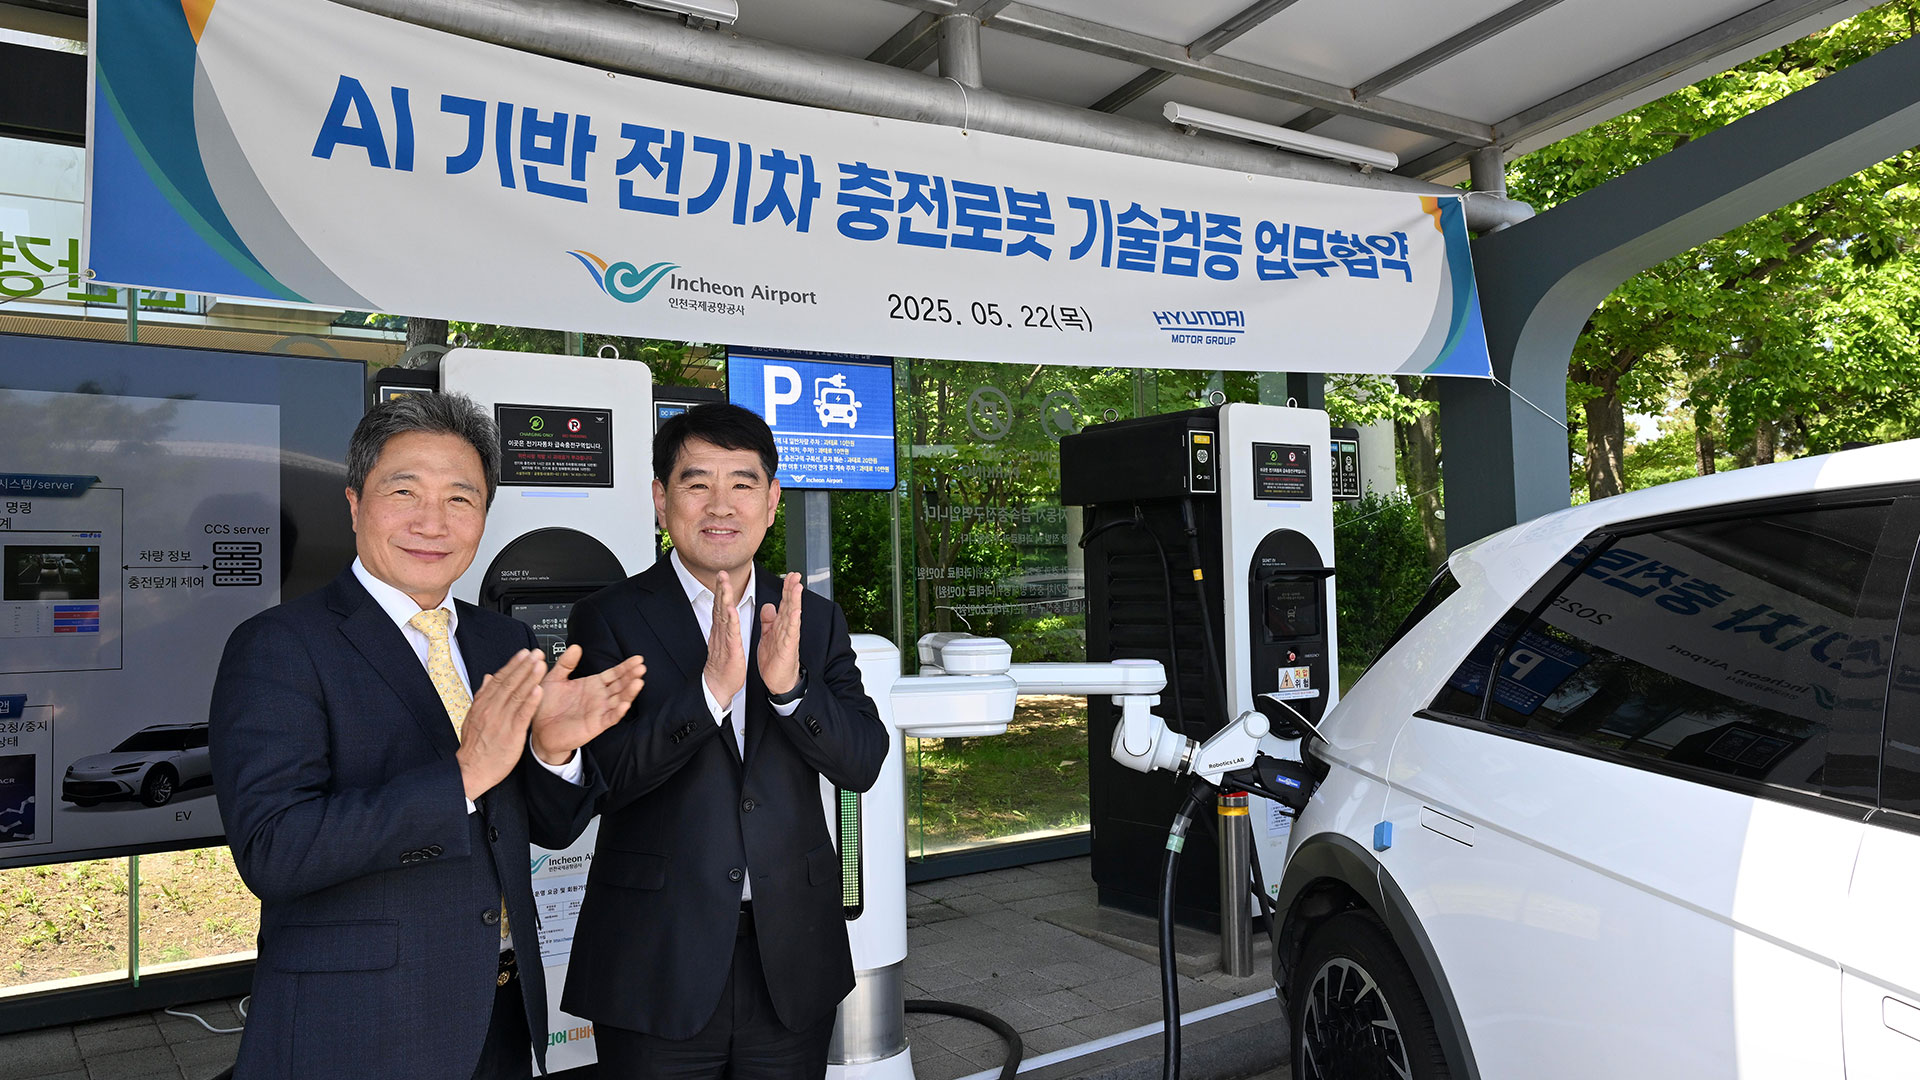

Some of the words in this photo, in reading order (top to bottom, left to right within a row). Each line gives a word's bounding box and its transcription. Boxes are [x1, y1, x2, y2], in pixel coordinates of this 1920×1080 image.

[311, 74, 415, 172] AI
[440, 94, 597, 204] 기반
[616, 122, 822, 234] 전기차
[836, 161, 1057, 262] 충전로봇
[1067, 196, 1243, 281] 기술검증
[1254, 218, 1414, 284] 업무협약
[669, 273, 745, 298] Incheon
[751, 284, 817, 305] Airport
[668, 297, 745, 316] 인천국제공항공사
[887, 293, 962, 326] 2025.
[971, 301, 1012, 329] 05.
[1020, 304, 1093, 332] 22(목)
[1153, 310, 1245, 328] HYUNDAI
[1171, 334, 1203, 345] MOTOR
[1205, 335, 1236, 346] GROUP
[763, 364, 803, 426] P
[6, 502, 32, 514] 명령
[204, 524, 230, 535] CCS
[233, 526, 270, 535] server
[139, 550, 164, 562] 차량
[167, 550, 192, 562] 정보
[128, 576, 177, 589] 충전덮개
[180, 576, 204, 588] 제어
[1208, 760, 1233, 769] Robotics
[175, 810, 192, 822] EV
[548, 855, 582, 866] Incheon
